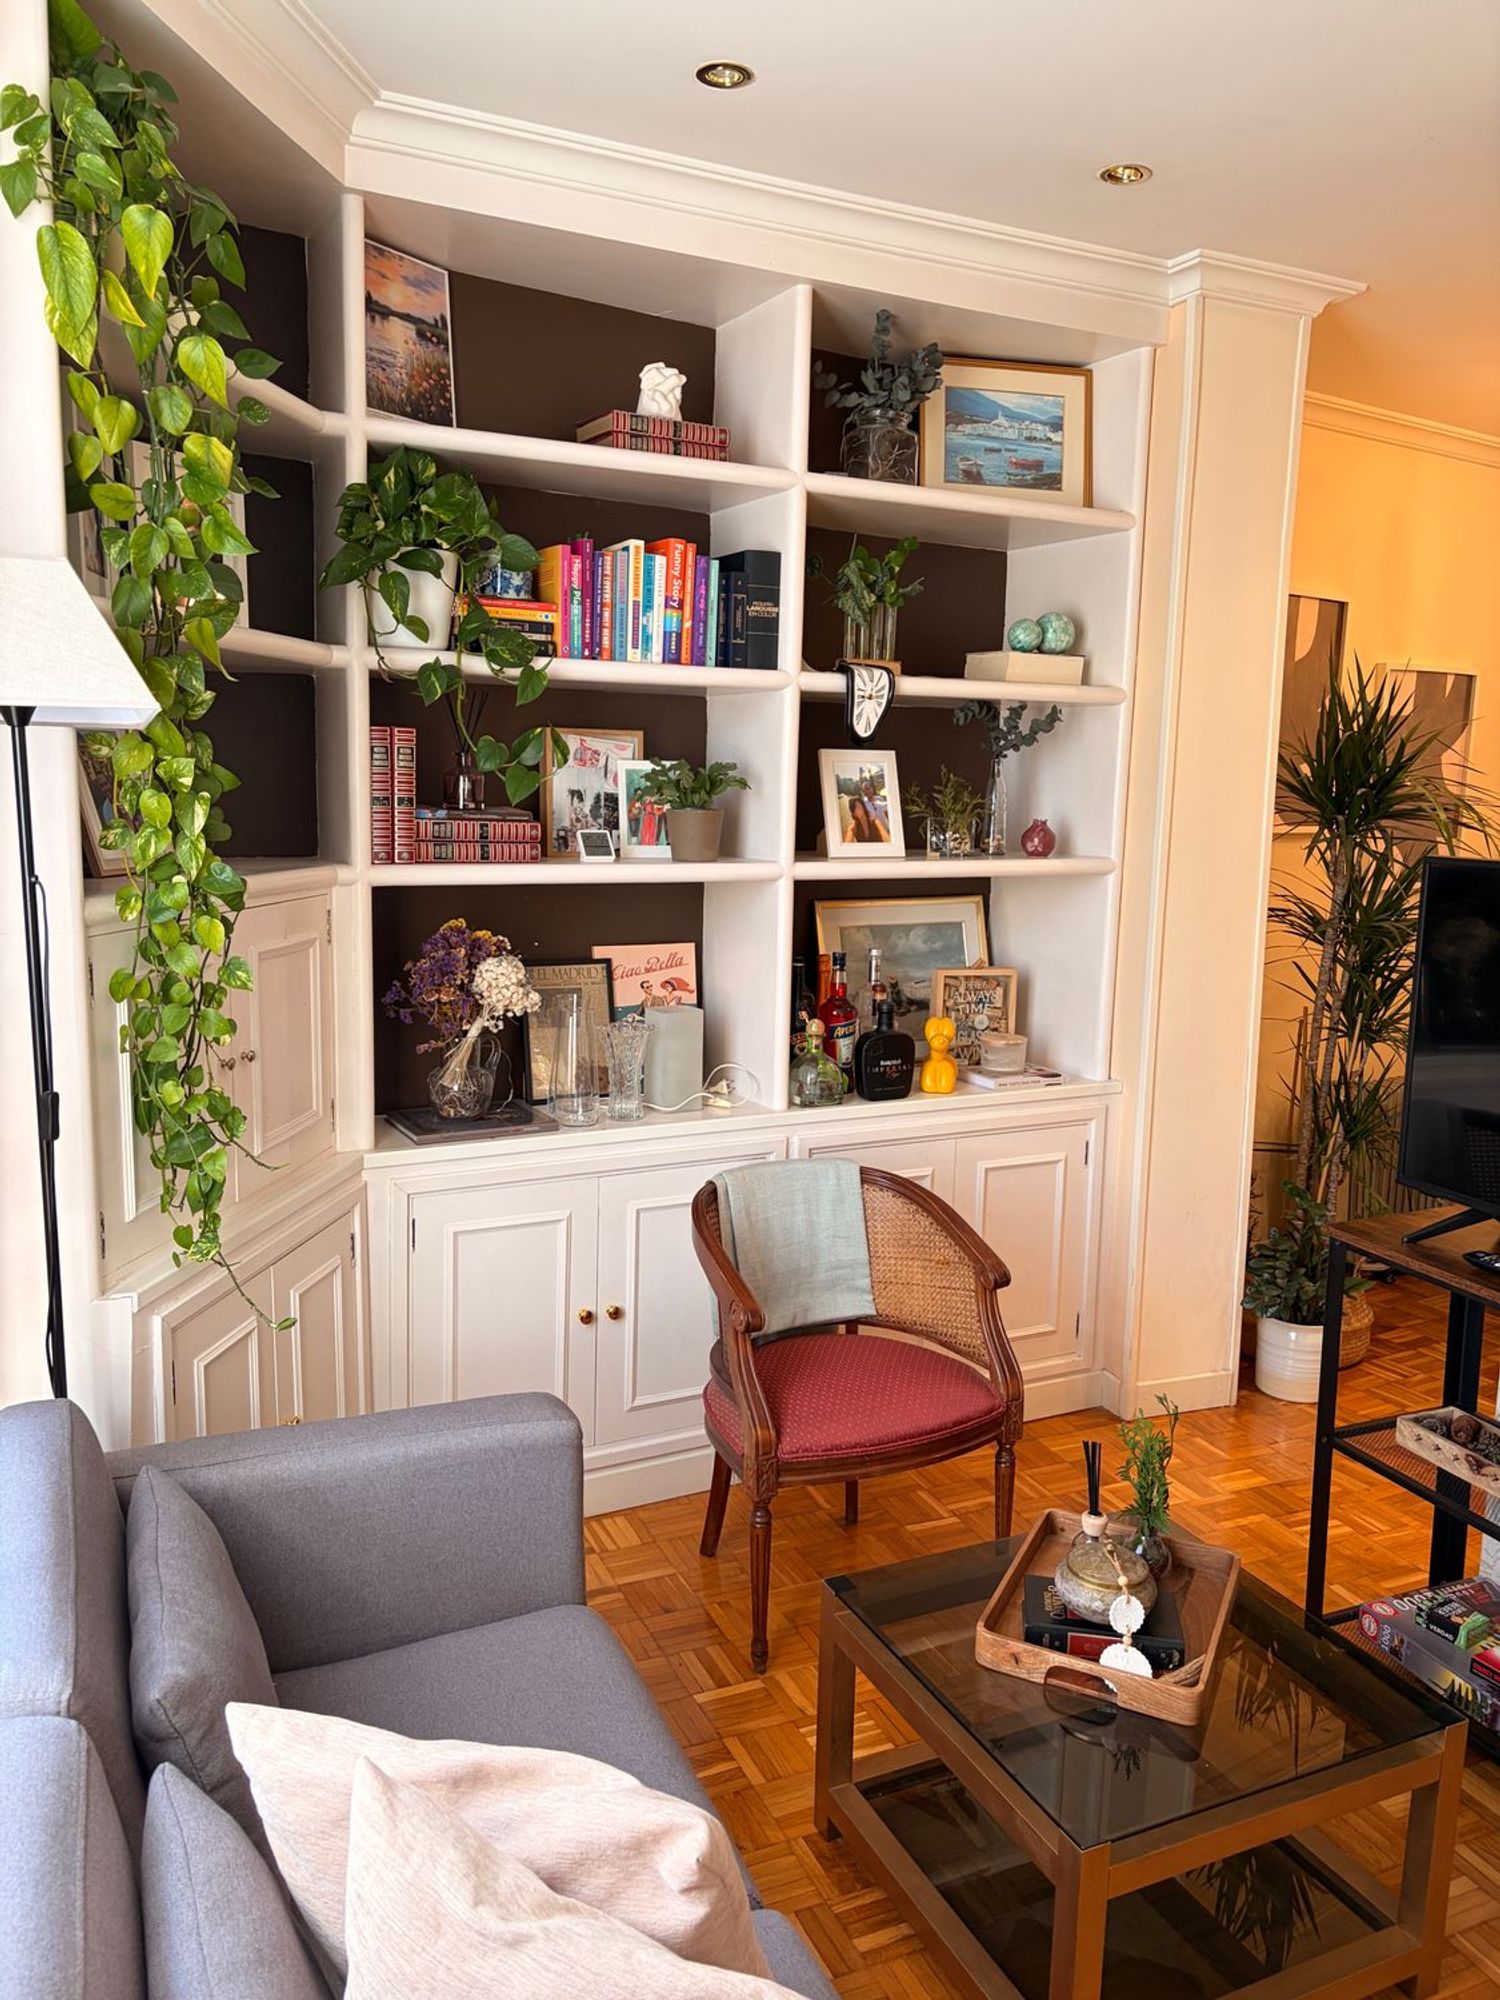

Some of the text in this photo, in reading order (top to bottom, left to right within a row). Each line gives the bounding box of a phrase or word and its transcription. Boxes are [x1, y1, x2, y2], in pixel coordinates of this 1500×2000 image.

[571, 559, 580, 589] Happy
[670, 544, 683, 608] Funny Story
[552, 966, 598, 980] MADRID
[612, 964, 642, 981] Ciao
[643, 951, 689, 974] Bella
[953, 990, 998, 1002] ALWAYS
[956, 1003, 992, 1014] TIME
[1429, 1624, 1455, 1640] VERDAD
